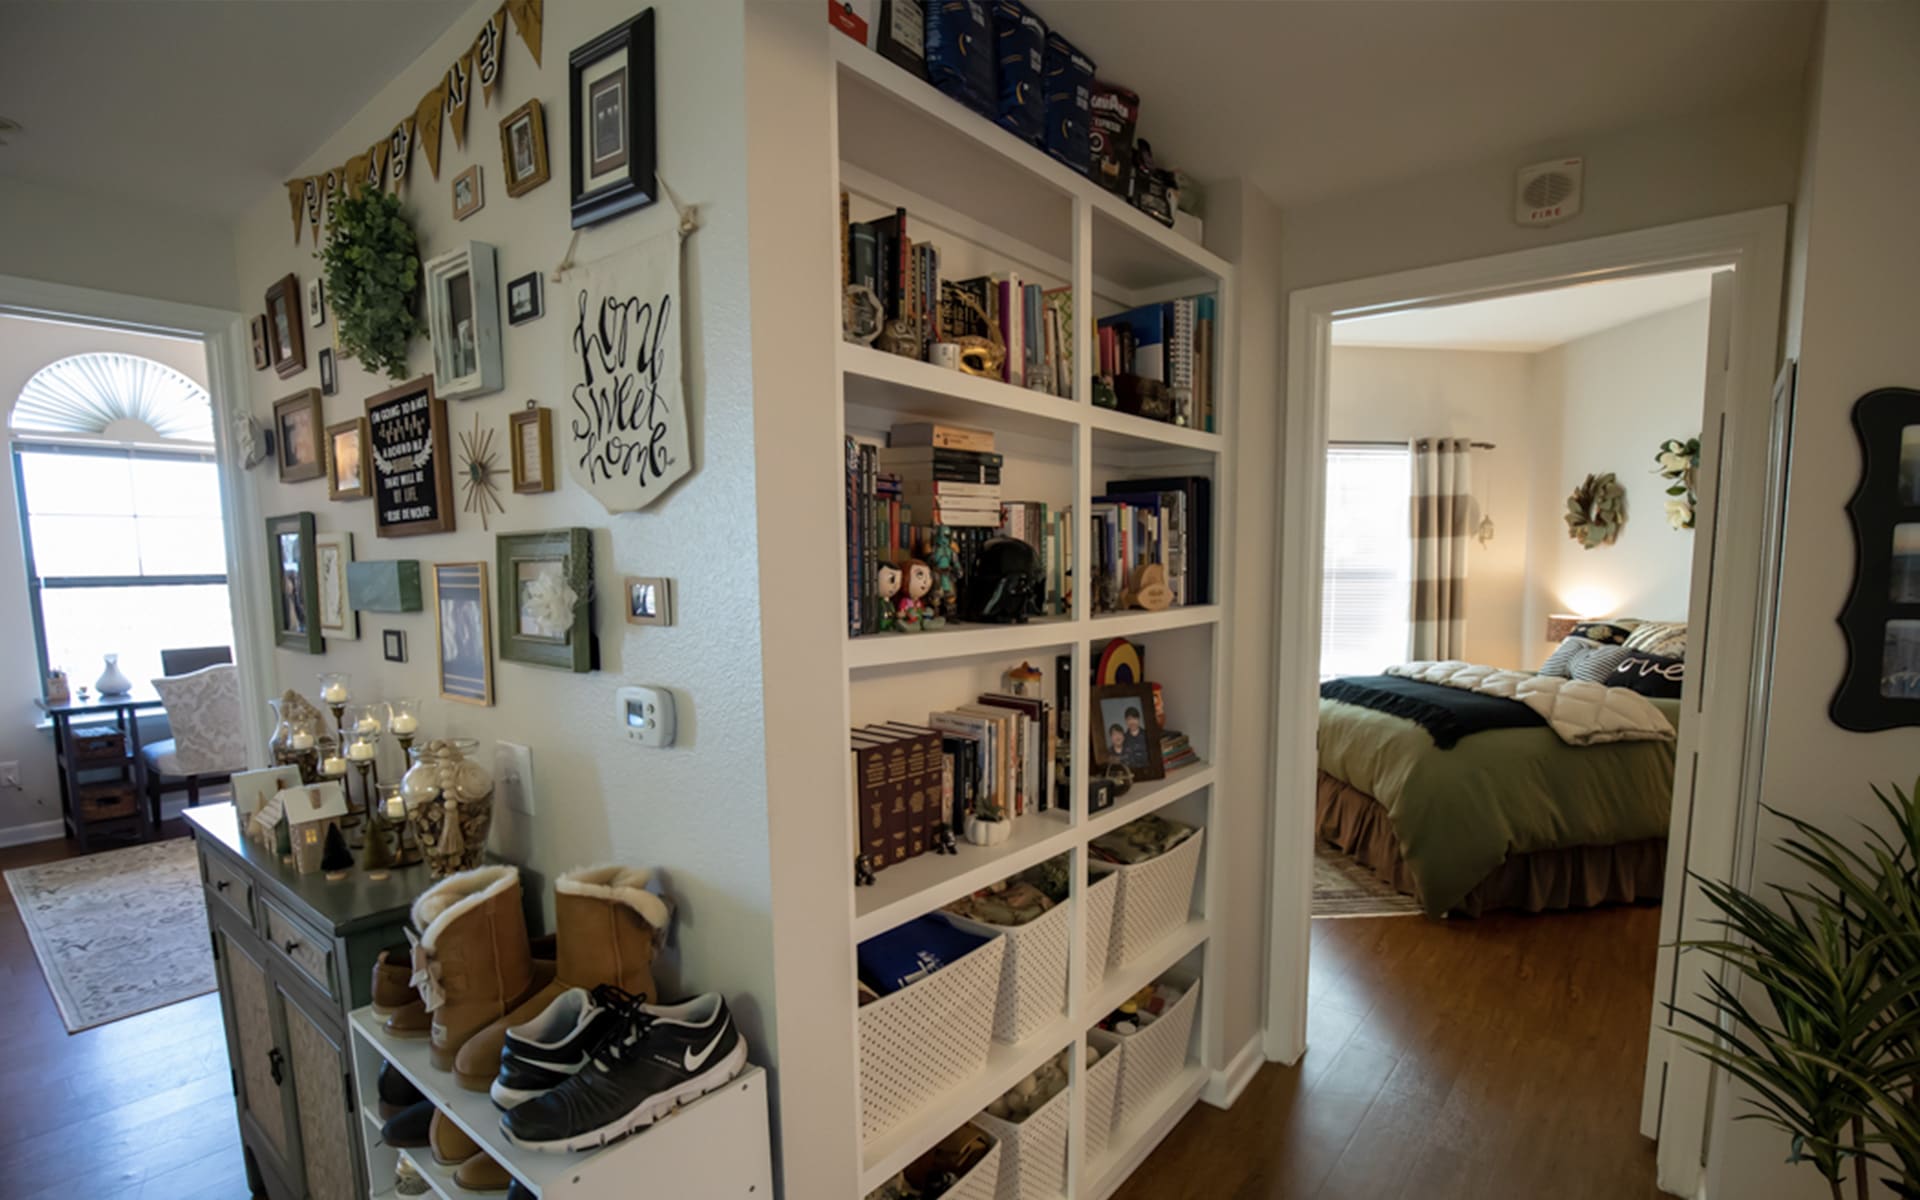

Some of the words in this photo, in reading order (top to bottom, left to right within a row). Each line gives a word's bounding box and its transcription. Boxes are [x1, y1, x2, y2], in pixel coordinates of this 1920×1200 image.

[447, 17, 498, 115] 사랑
[1531, 207, 1561, 219] FIRE
[572, 374, 670, 441] sweet
[580, 422, 675, 487] home
[1617, 656, 1685, 681] ove
